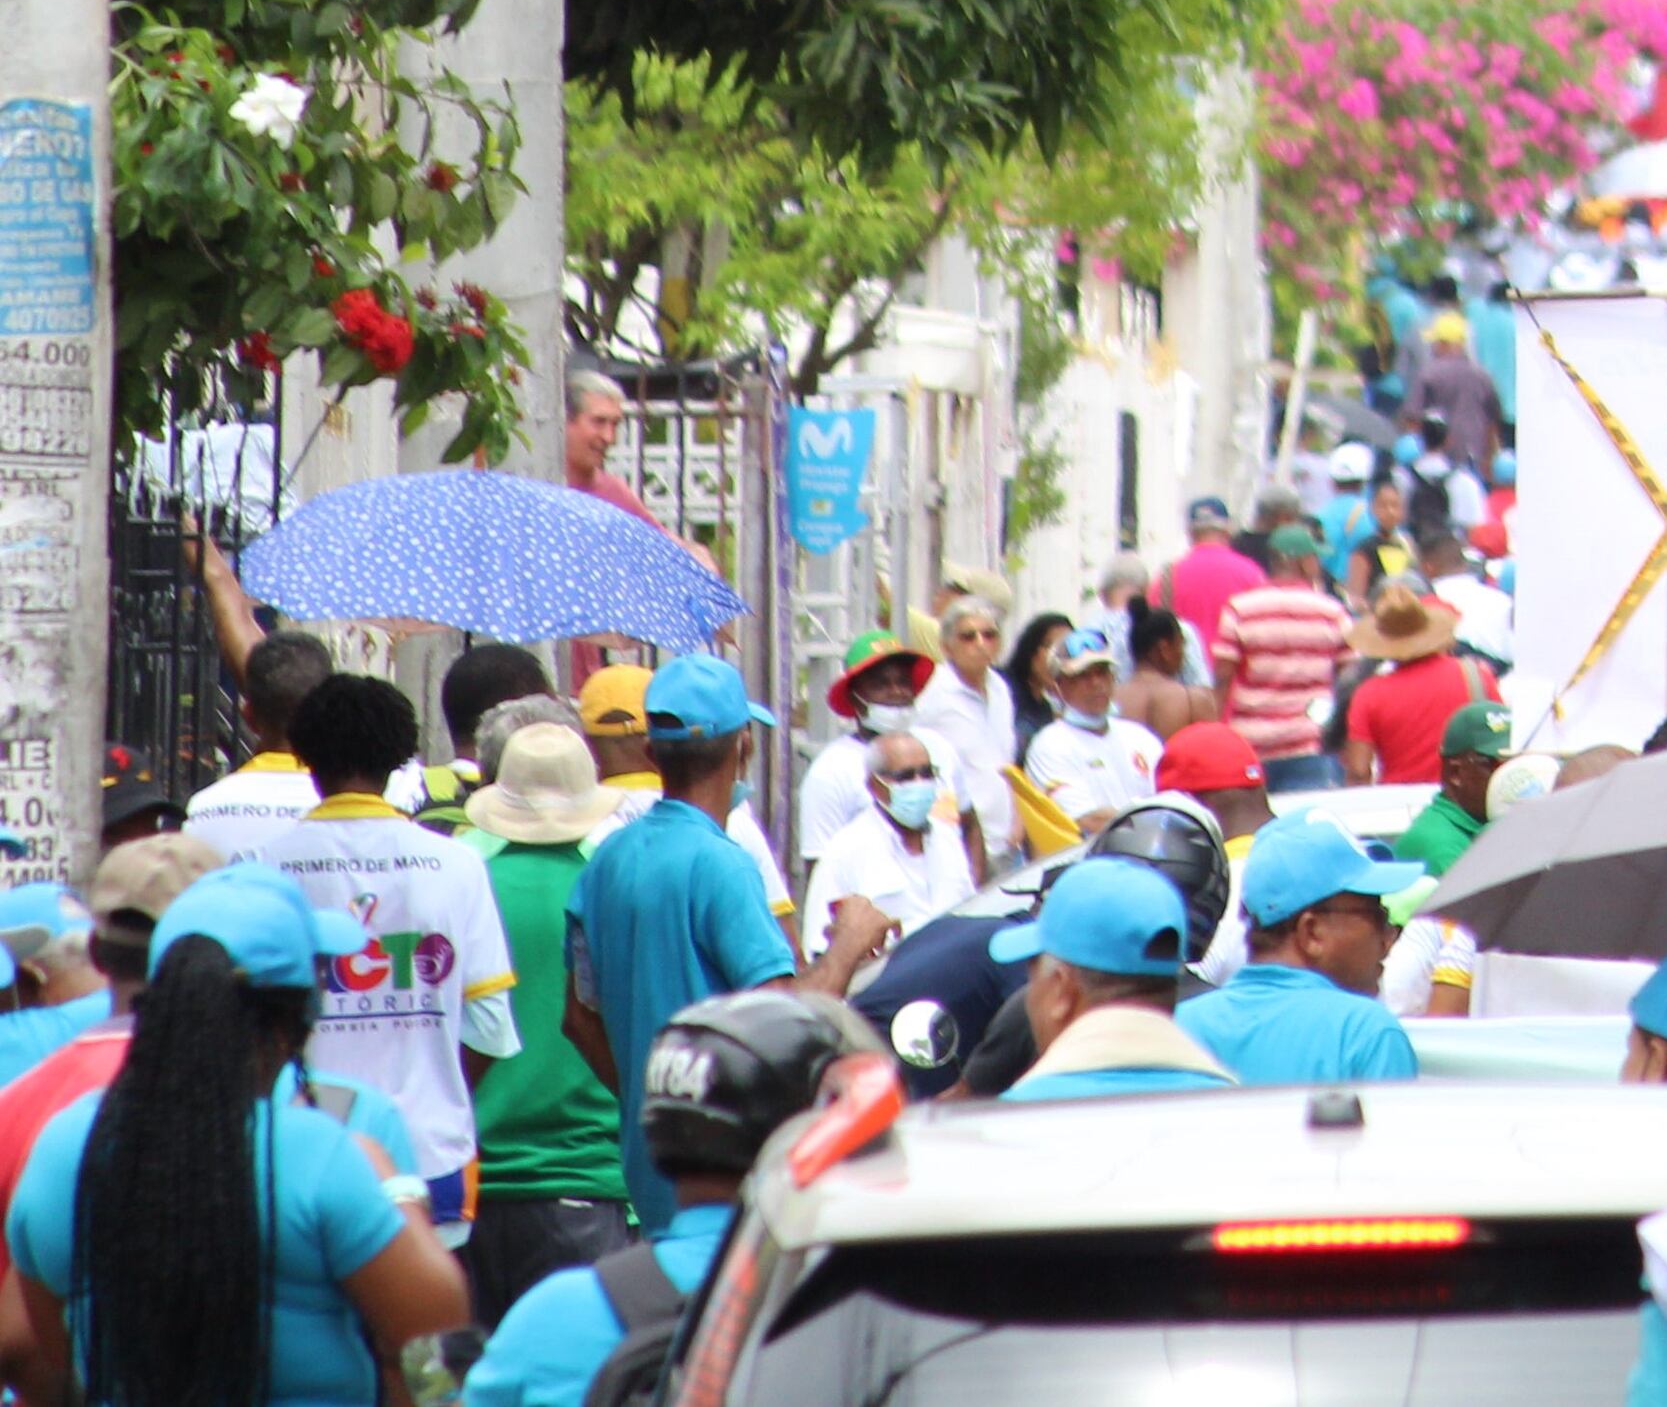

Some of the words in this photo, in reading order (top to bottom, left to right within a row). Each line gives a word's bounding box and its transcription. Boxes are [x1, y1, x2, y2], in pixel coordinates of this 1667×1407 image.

[279, 856, 361, 875] PRIMERO
[365, 857, 389, 873] DE
[393, 854, 442, 873] MAYO
